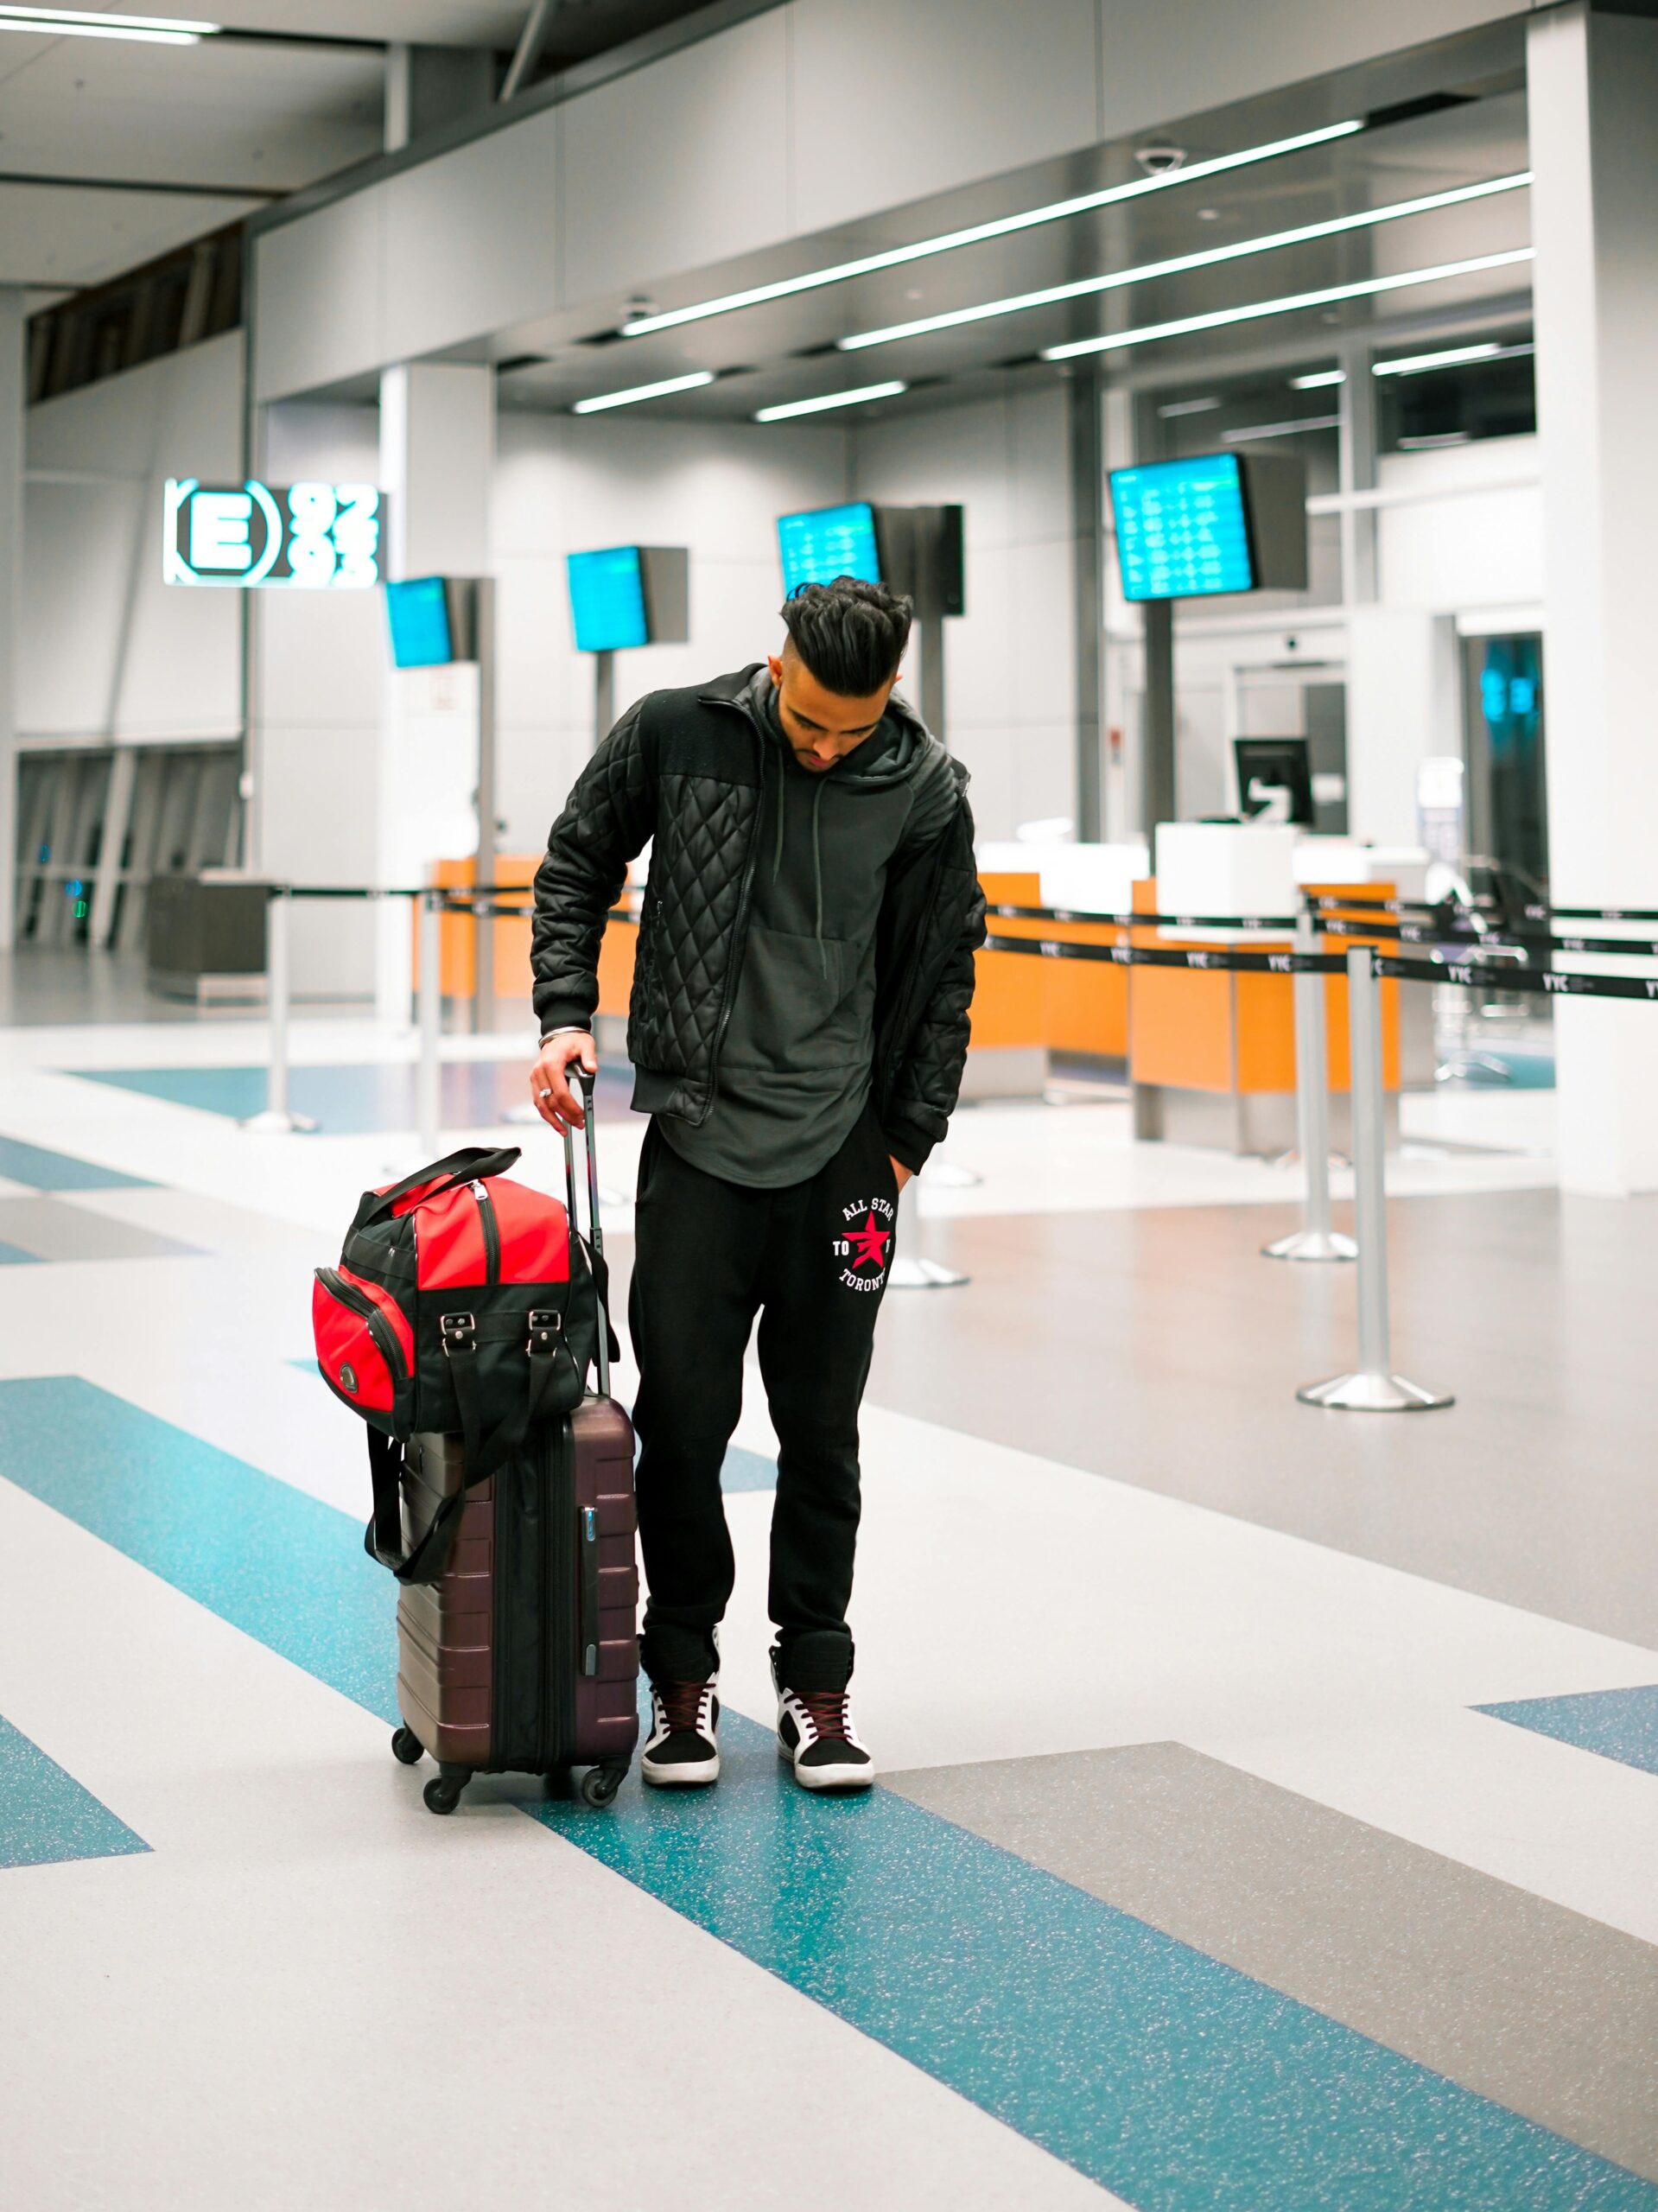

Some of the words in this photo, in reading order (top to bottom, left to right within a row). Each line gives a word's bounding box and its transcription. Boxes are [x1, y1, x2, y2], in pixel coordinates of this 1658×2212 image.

[190, 491, 252, 570] E
[1542, 973, 1569, 993] YYC
[842, 1199, 868, 1221] ALL
[871, 1198, 894, 1222] STAR
[832, 1241, 849, 1256] TO
[839, 1268, 886, 1292] TORONT
